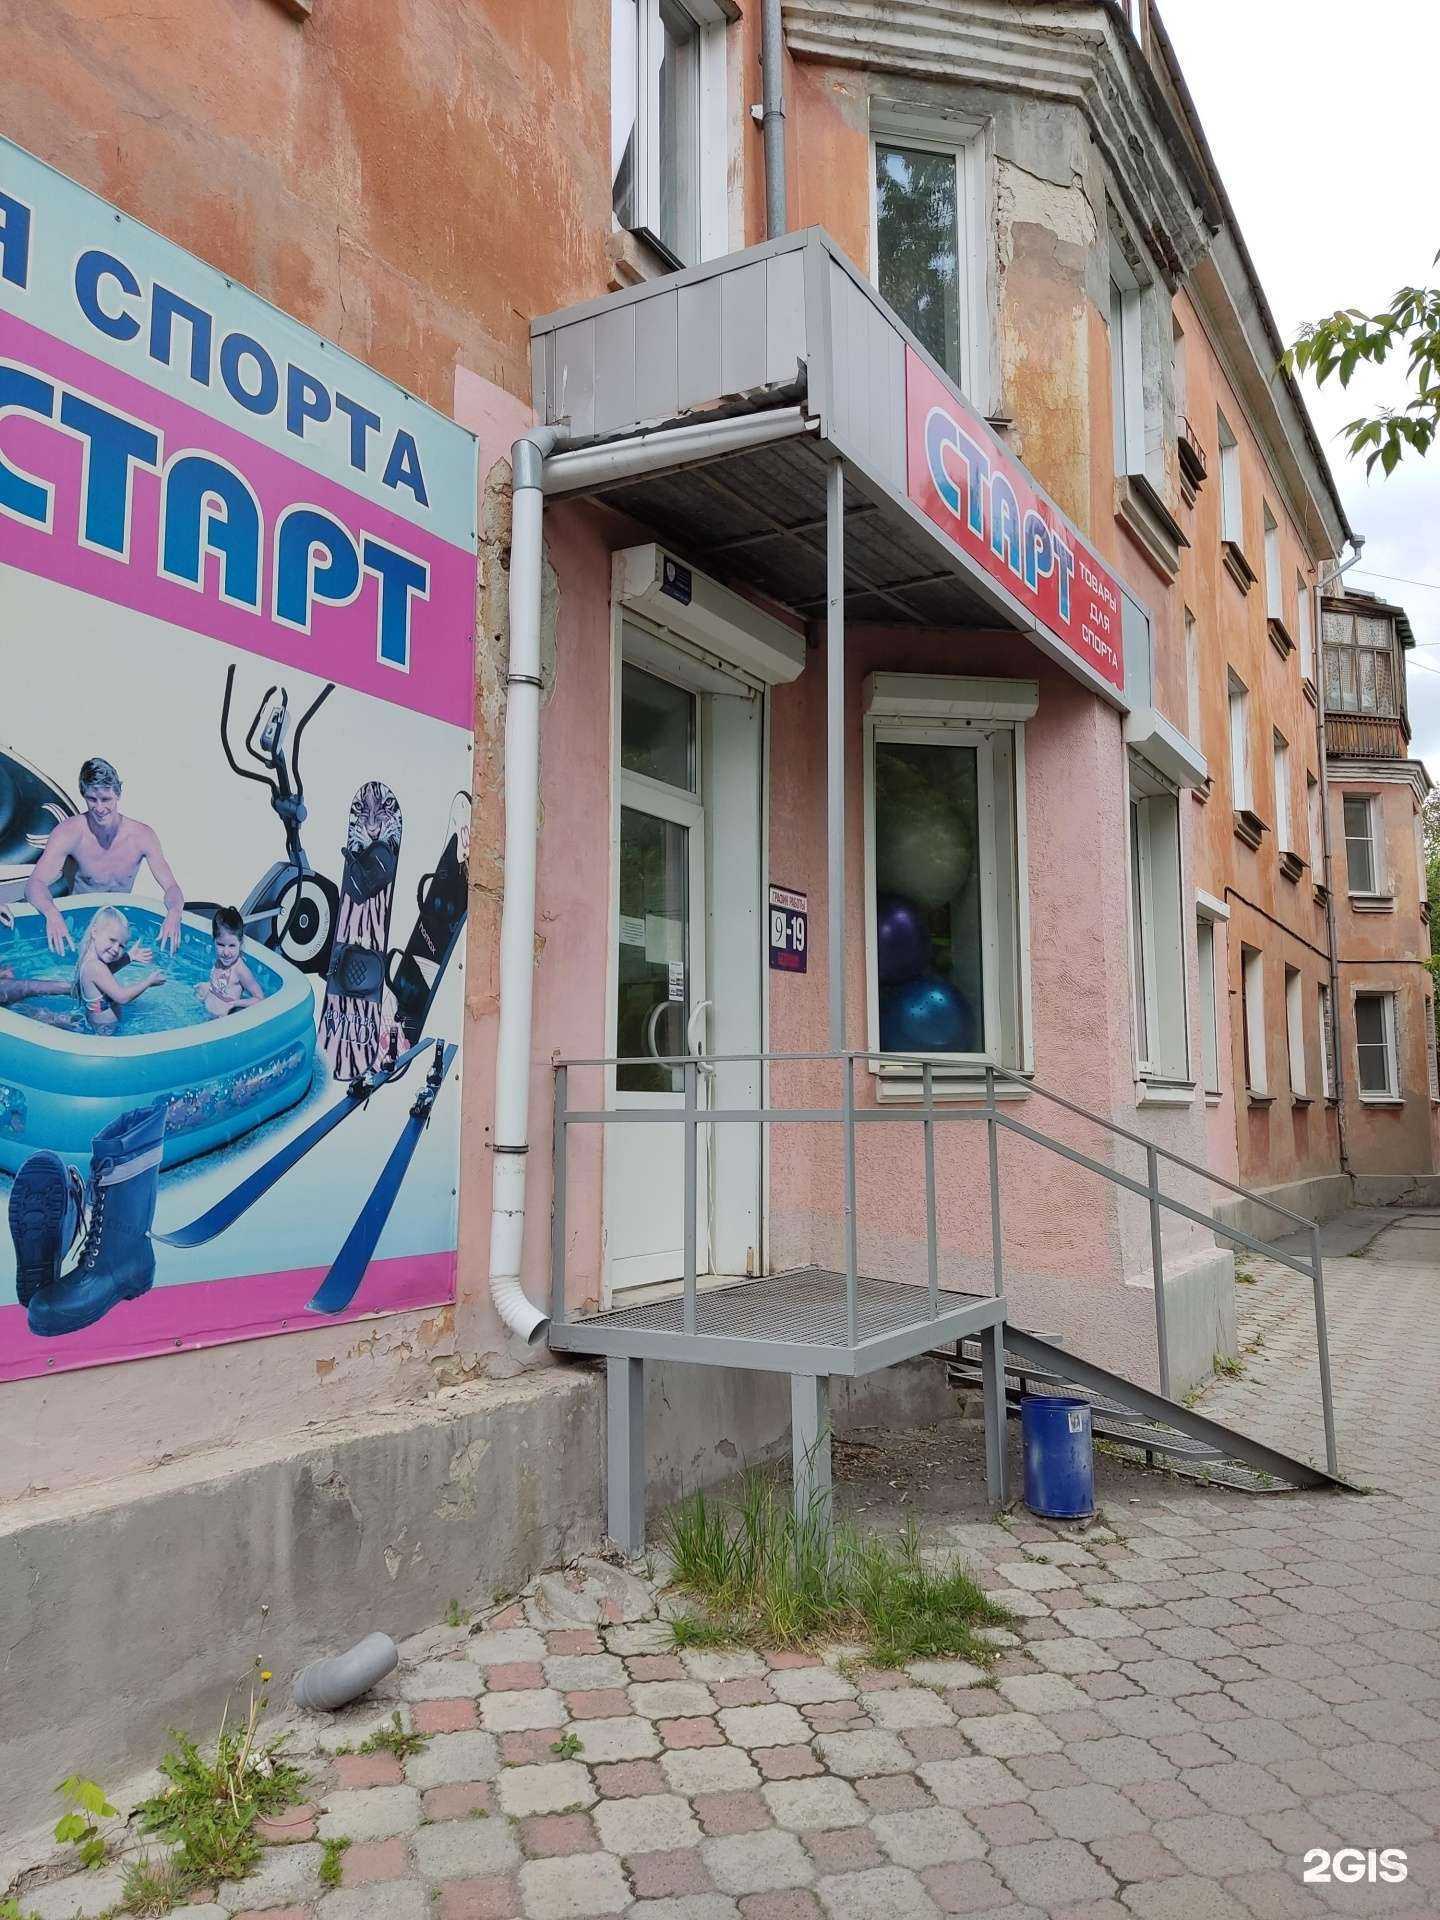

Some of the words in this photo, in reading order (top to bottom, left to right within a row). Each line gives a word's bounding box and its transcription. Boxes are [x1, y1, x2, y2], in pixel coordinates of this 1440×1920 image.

[75, 250, 430, 508] СПОРТА
[0, 364, 429, 669] СТАРТ
[924, 405, 1075, 626] СТАРТ
[1079, 559, 1117, 614] ТОВАРЫ
[1081, 623, 1119, 670] СПОРТА
[1090, 602, 1110, 634] ДЛЯ
